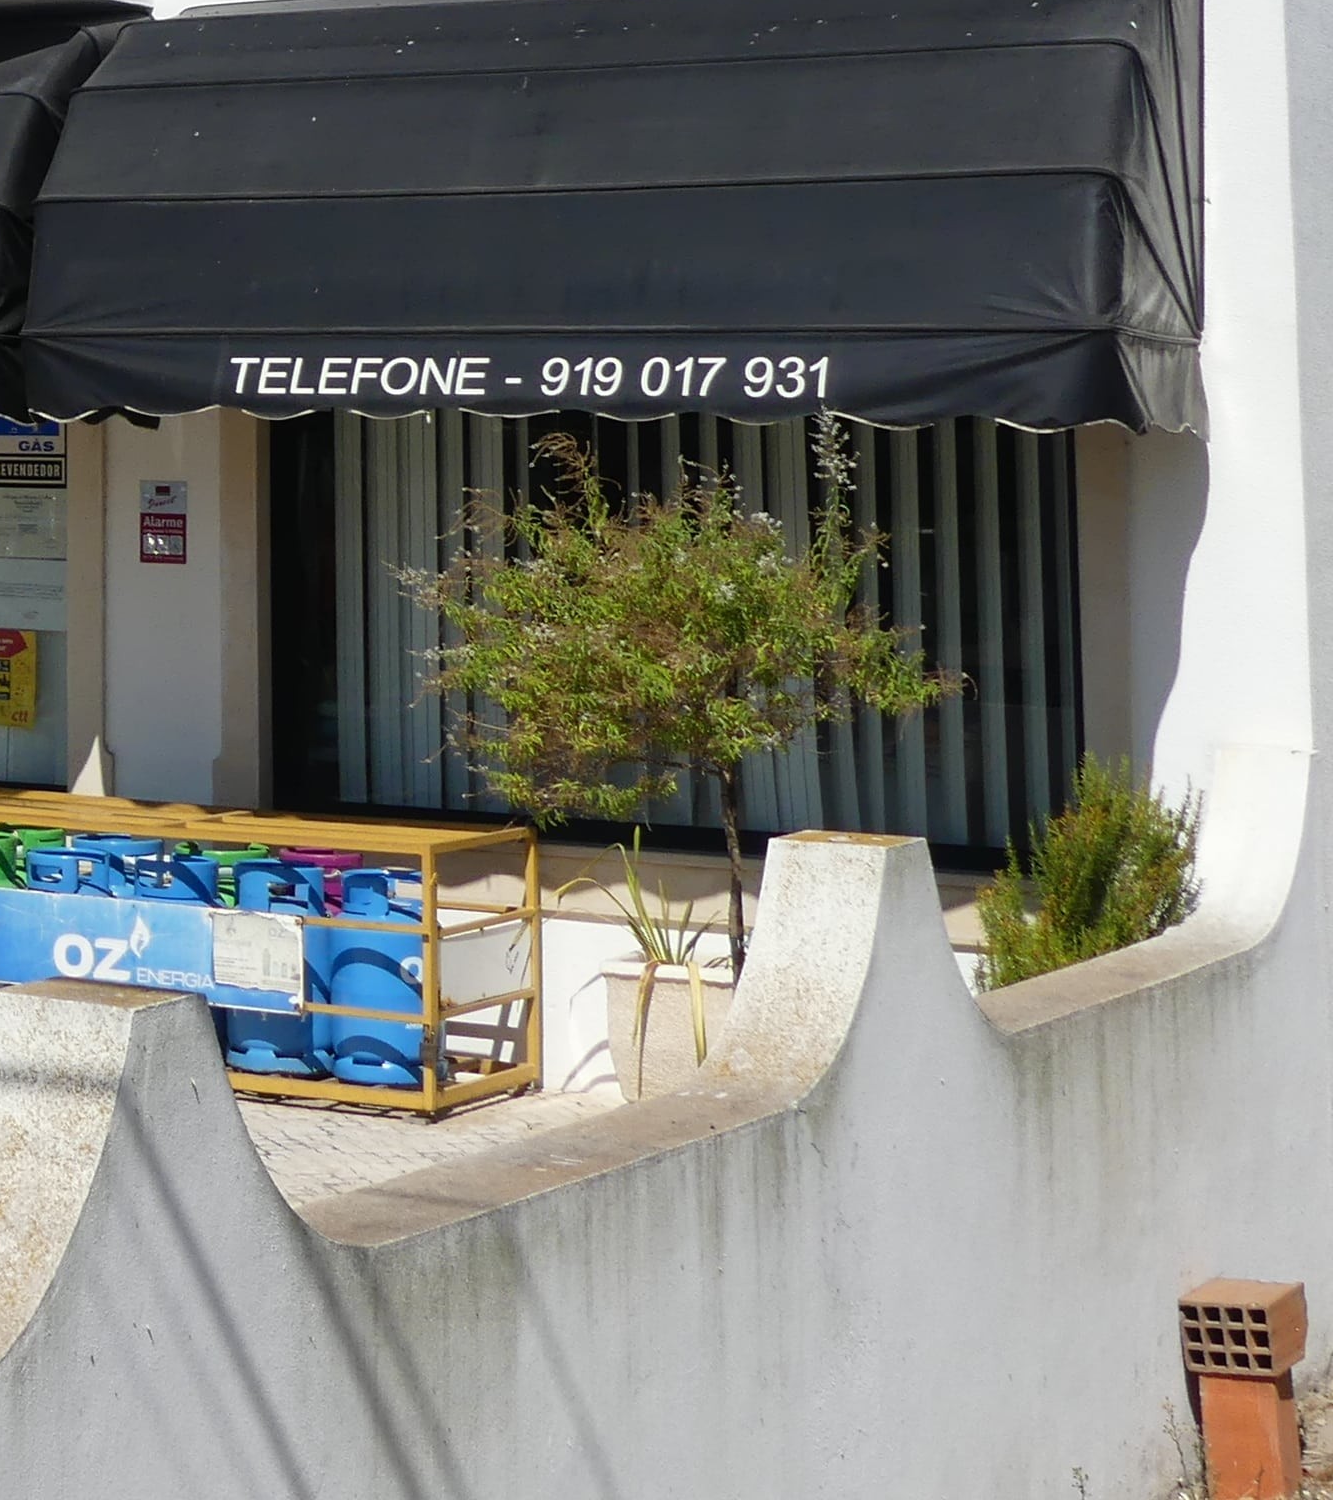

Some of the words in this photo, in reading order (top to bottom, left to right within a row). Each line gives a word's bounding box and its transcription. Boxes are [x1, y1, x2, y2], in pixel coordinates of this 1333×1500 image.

[229, 356, 491, 396] TELEFONE
[540, 356, 624, 397] 919
[640, 356, 727, 398] 017
[743, 355, 831, 399] 931
[142, 515, 184, 529] Alarme
[11, 710, 29, 723] ctt
[53, 933, 132, 982] OZ
[136, 967, 216, 991] ENERGIA
